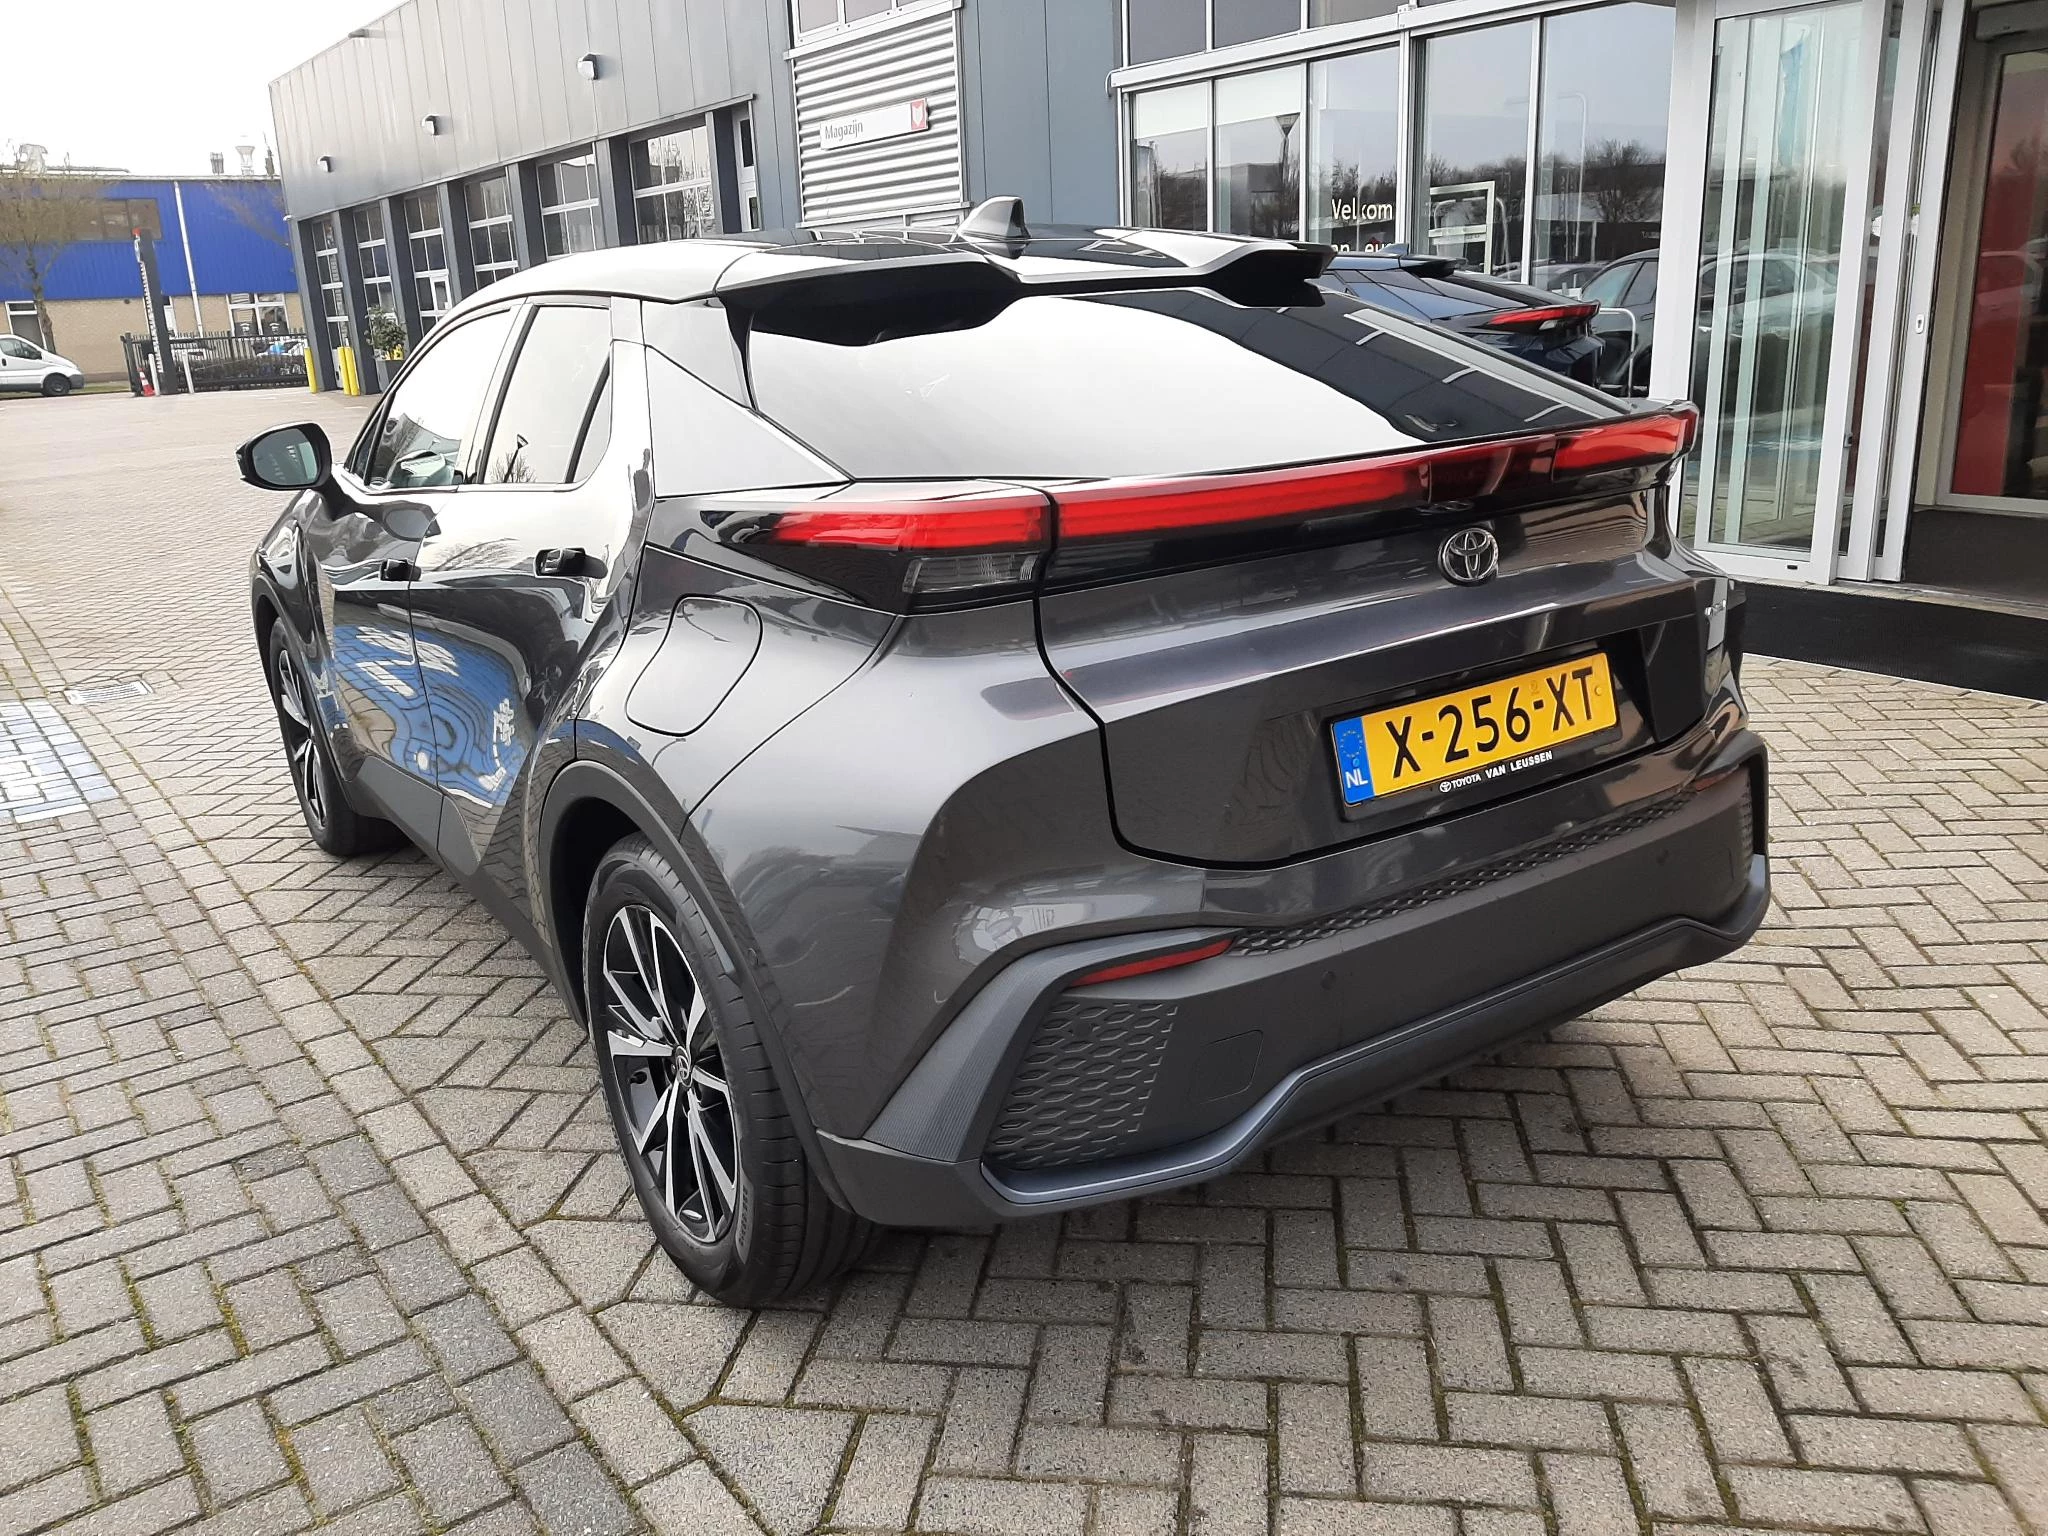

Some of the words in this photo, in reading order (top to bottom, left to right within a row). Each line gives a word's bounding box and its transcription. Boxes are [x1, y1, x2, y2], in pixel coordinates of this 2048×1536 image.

[825, 119, 864, 141] Magazijn
[1385, 666, 1593, 779] X-256-XT
[1345, 769, 1368, 788] NL
[1451, 773, 1482, 789] TOYOTA
[1485, 764, 1507, 779] VAN
[1510, 750, 1553, 771] LEUSSEN
